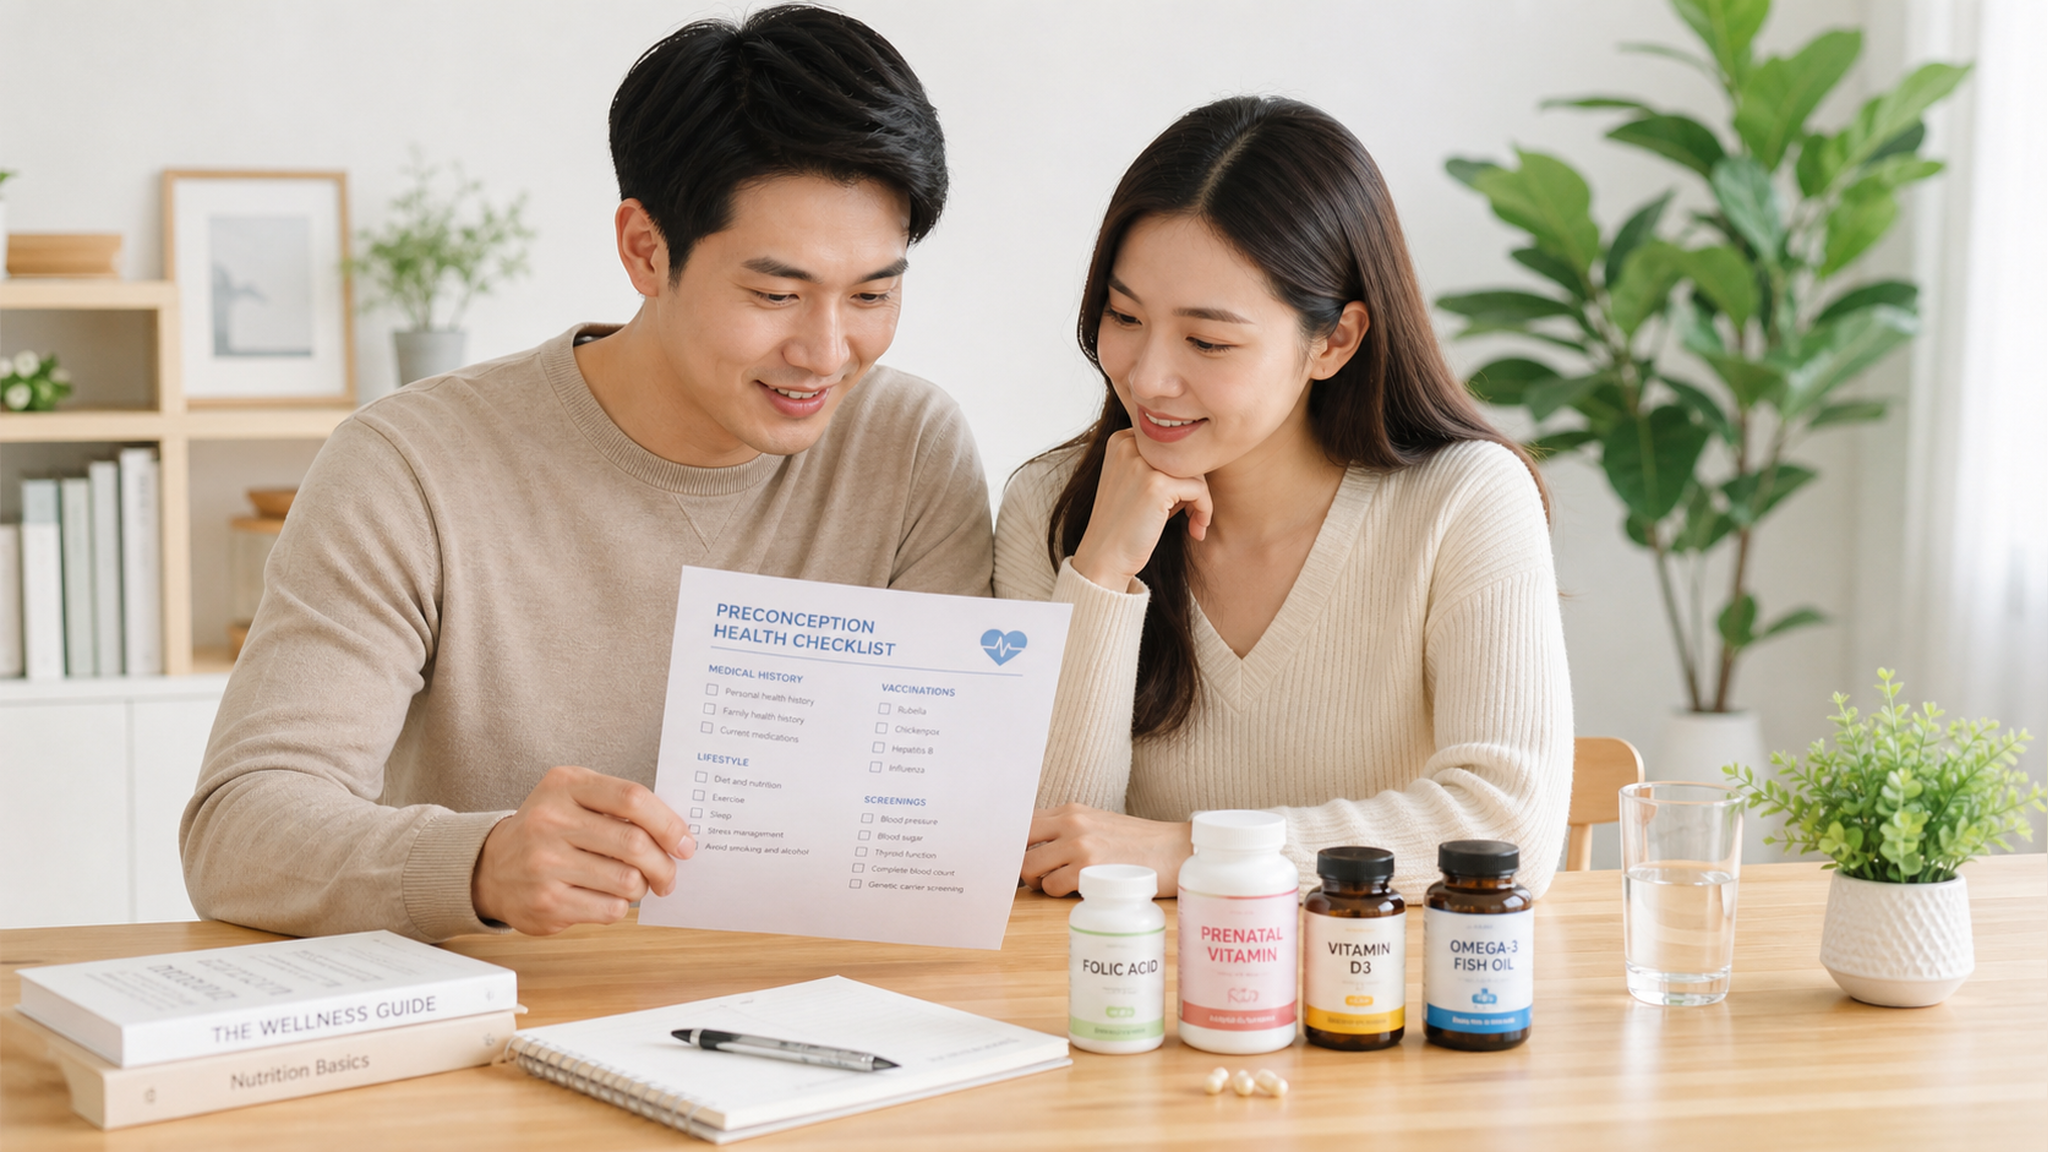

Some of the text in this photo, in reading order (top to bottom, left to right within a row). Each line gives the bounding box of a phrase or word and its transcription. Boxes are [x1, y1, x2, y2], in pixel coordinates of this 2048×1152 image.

[716, 603, 875, 634] PRECONCEPTION
[713, 624, 896, 656] HEALTH CHECKLIST
[708, 664, 803, 683] MEDICAL HISTORY
[726, 688, 815, 706] Personal health history
[882, 683, 956, 697] VACCINATIONS
[723, 707, 749, 719] Family
[778, 714, 804, 725] history
[720, 726, 799, 743] Current medications
[697, 753, 749, 767] LIFESTYLE
[749, 780, 782, 789] nutrition
[864, 795, 926, 806] SCREENINGS
[710, 811, 732, 820] Sleep
[880, 815, 903, 824] Blood
[877, 832, 900, 841] Blood
[871, 865, 908, 874] Complete
[1201, 926, 1283, 943] PRENATAL
[1328, 942, 1390, 956] VITAMIN
[1450, 940, 1518, 954] OMEGA-3
[1207, 946, 1277, 963] VITAMIN
[1083, 959, 1158, 976] FOLIC ACID
[1350, 961, 1372, 974] D3
[1454, 957, 1514, 971] FISH OIL
[211, 996, 437, 1043] THE WELLNESS GUIDE
[230, 1054, 370, 1090] Nutrition Basics
